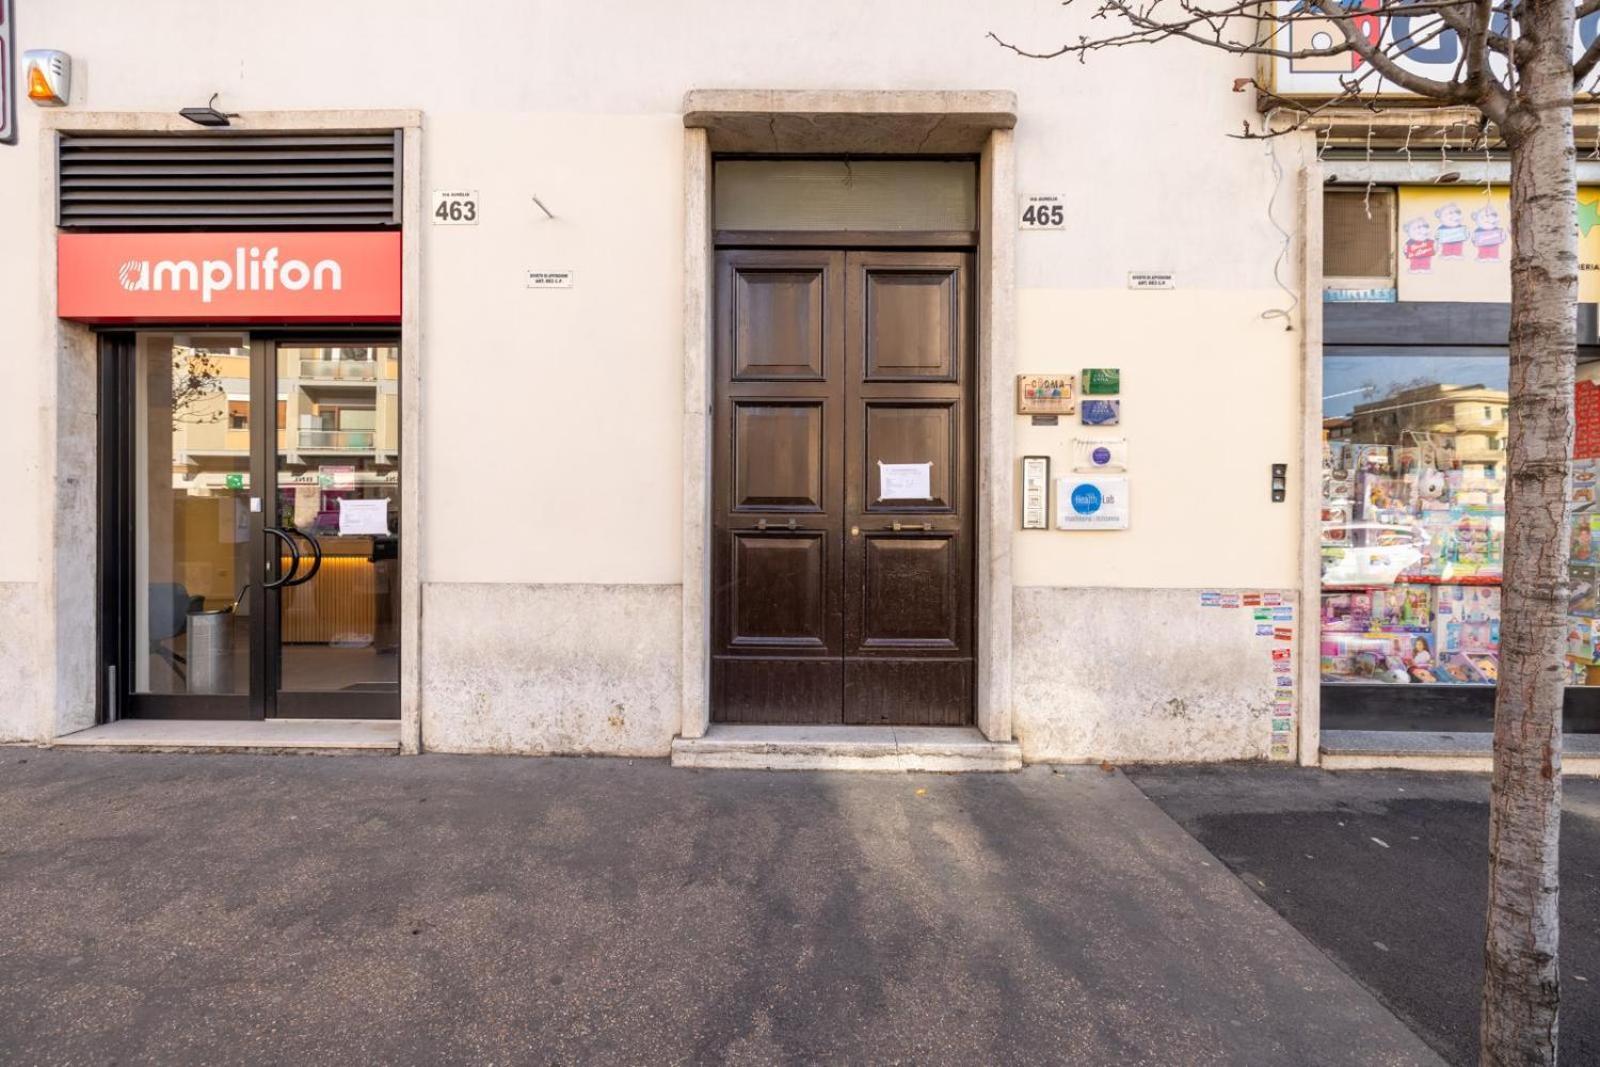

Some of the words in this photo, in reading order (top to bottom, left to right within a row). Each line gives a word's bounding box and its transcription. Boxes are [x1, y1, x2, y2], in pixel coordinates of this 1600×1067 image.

[435, 200, 476, 221] 463
[1022, 205, 1064, 226] 465
[118, 246, 342, 302] amplifon
[1102, 494, 1115, 505] Lab
